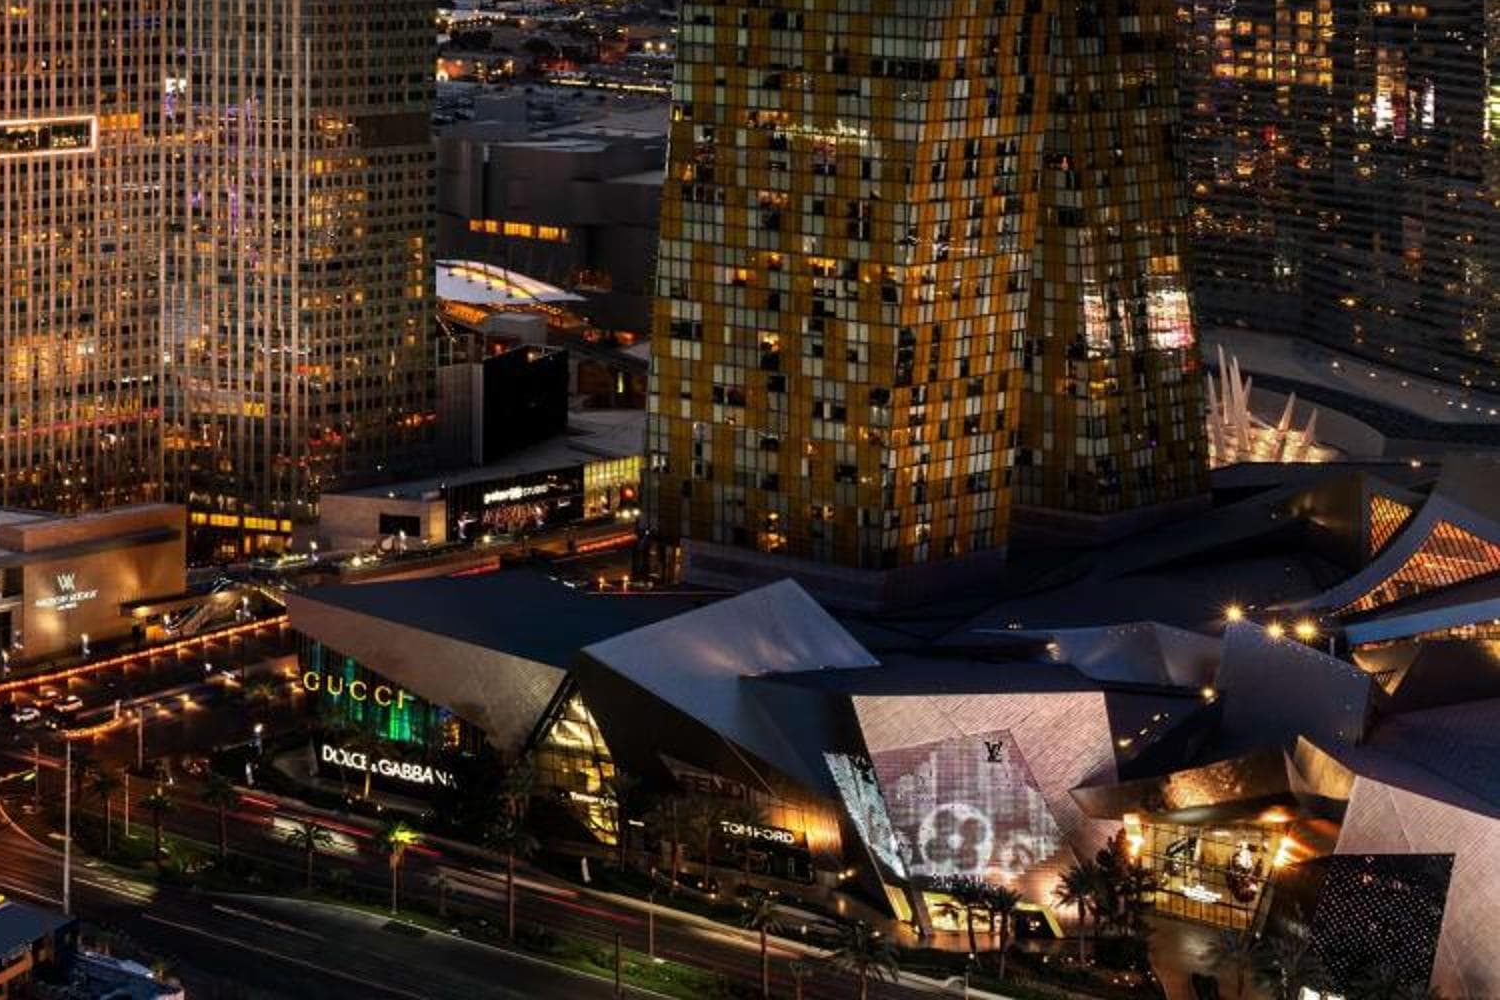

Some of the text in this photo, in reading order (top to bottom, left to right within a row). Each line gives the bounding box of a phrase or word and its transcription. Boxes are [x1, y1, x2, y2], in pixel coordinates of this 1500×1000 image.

[303, 671, 404, 709] GUCCI
[322, 744, 367, 770] DOLCE
[720, 820, 795, 844] TOM FORD
